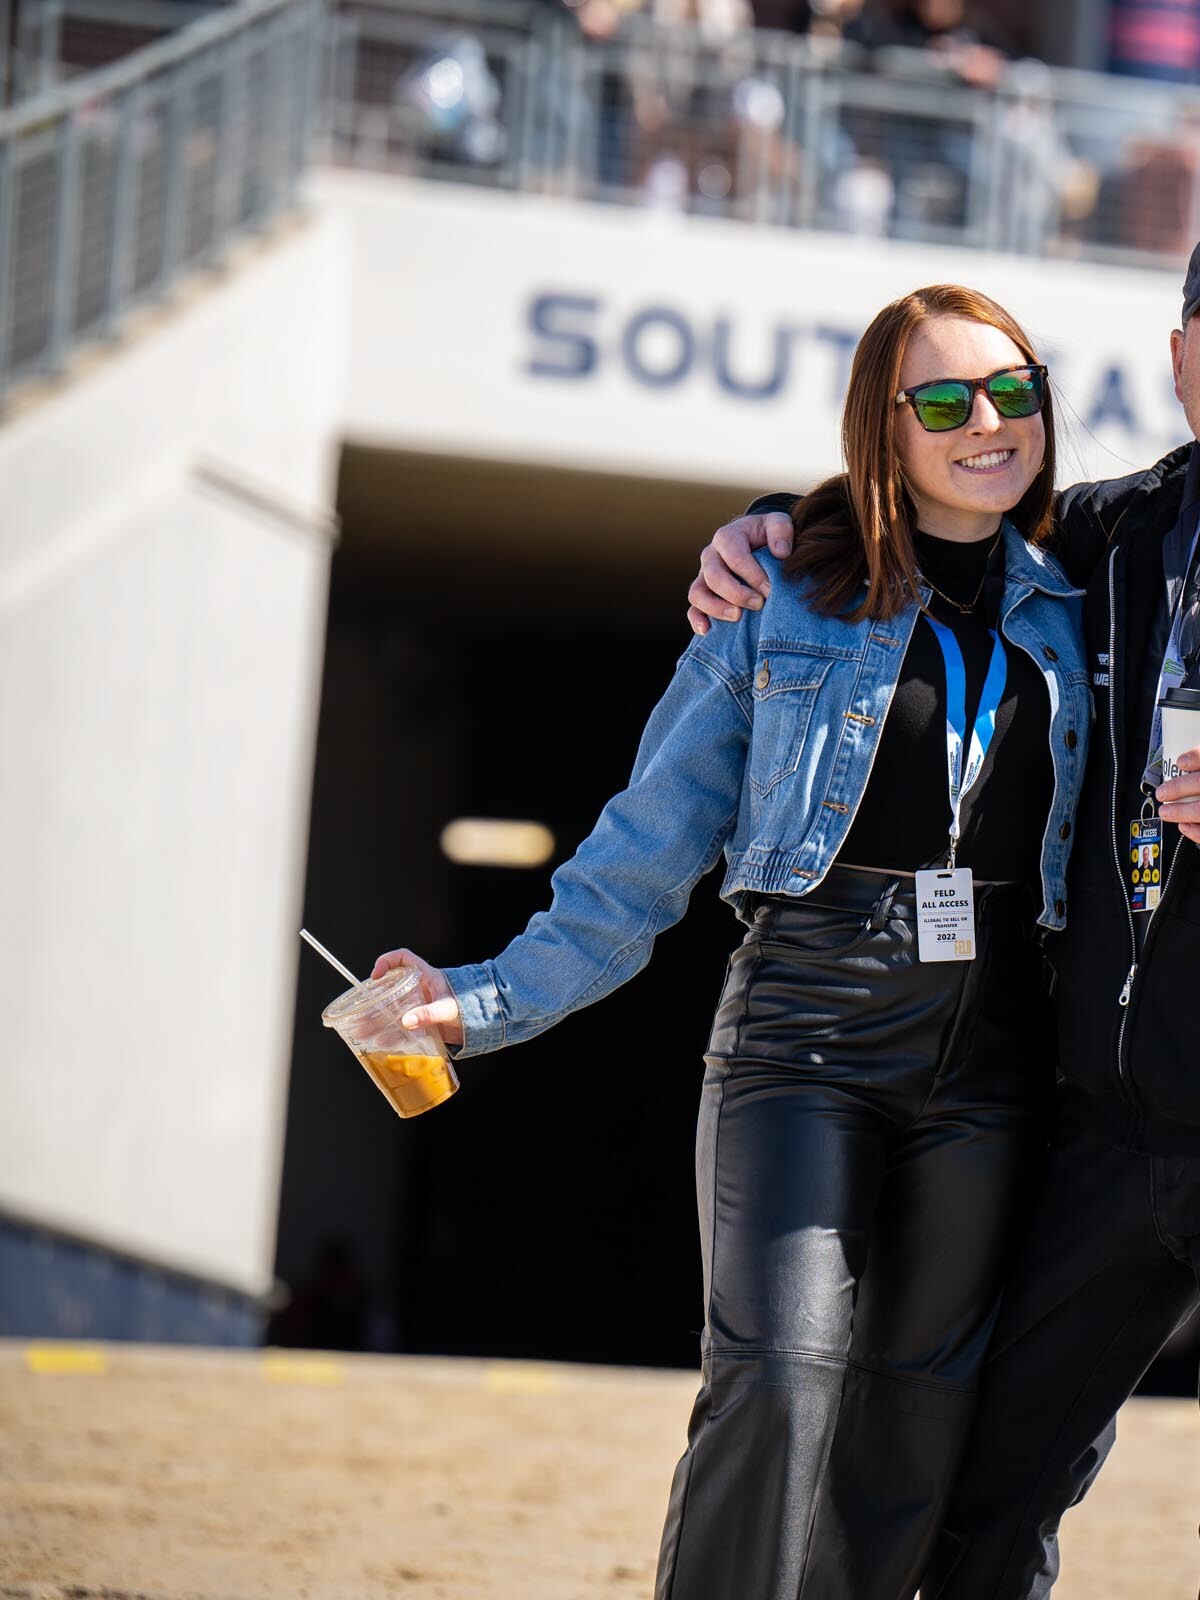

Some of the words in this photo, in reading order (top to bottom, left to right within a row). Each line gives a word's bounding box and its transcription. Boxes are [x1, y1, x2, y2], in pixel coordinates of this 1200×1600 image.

[523, 289, 860, 401] SOUT
[934, 889, 956, 898] FELD
[921, 901, 937, 909] ALL
[938, 899, 969, 909] ACCESS
[936, 933, 957, 941] 2022
